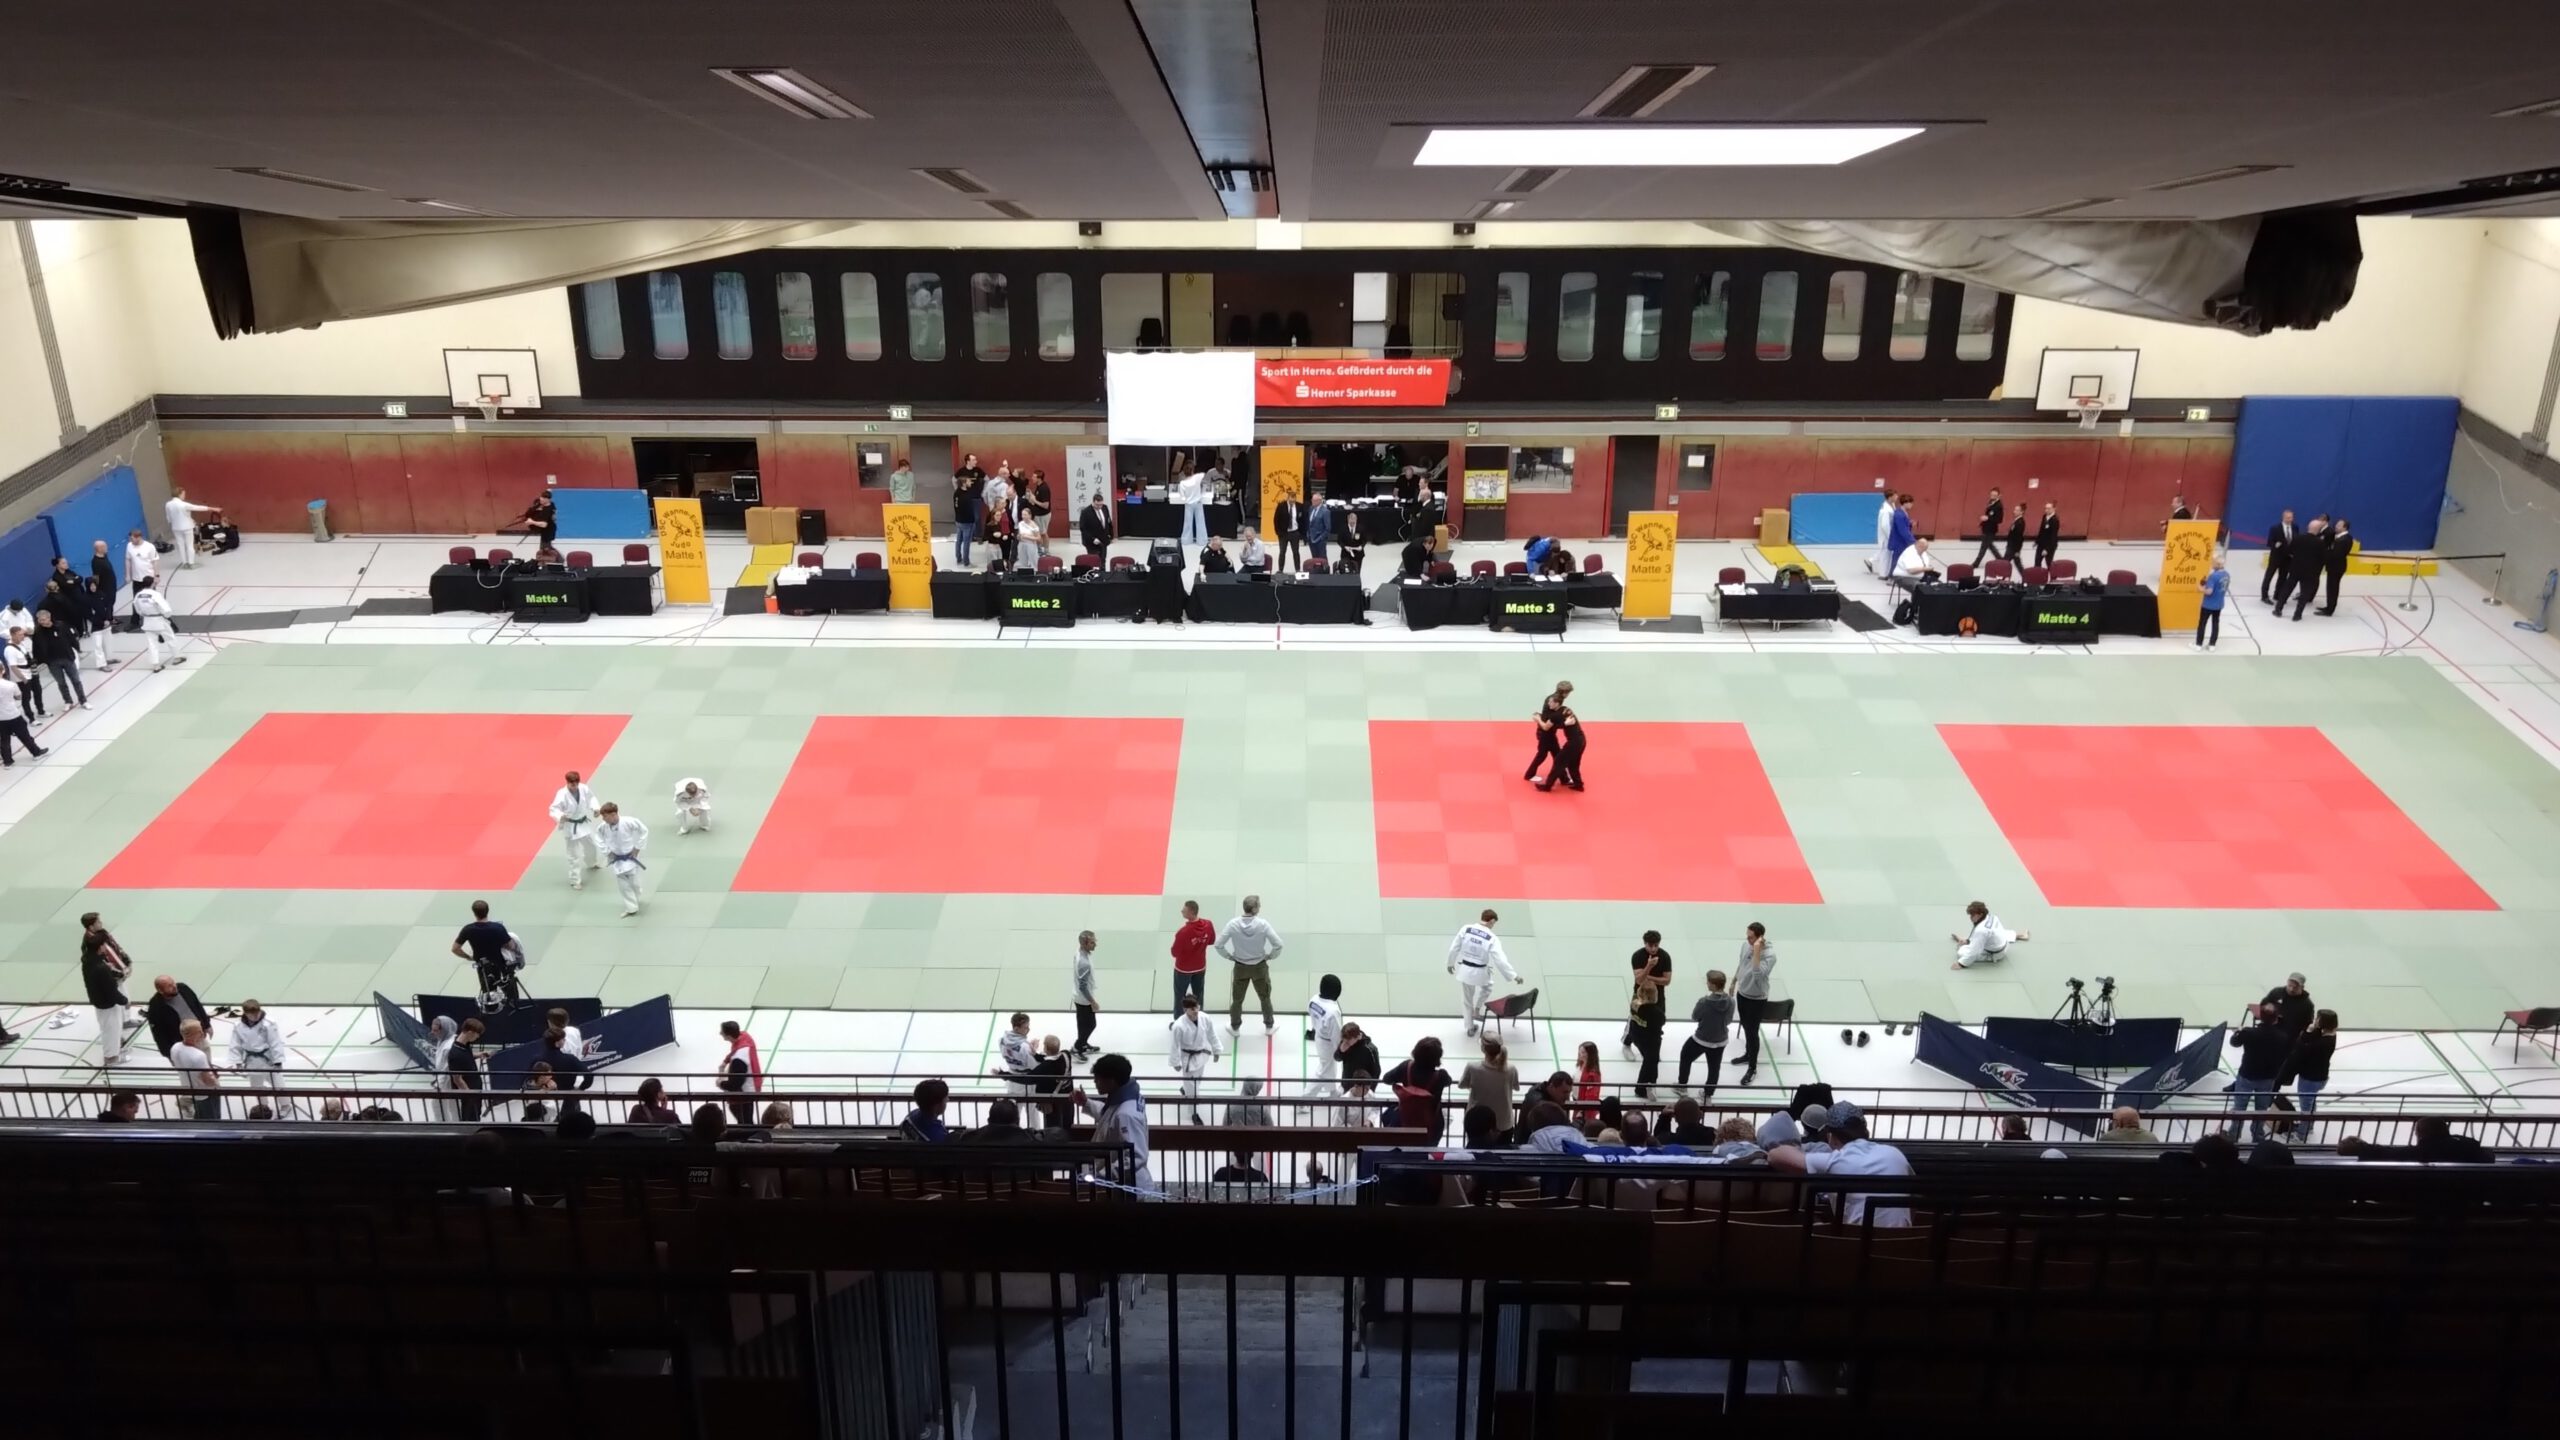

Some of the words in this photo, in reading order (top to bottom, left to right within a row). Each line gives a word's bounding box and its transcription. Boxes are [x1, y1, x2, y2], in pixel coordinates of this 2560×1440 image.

[1261, 367, 1288, 378] Sport
[1290, 366, 1300, 376] in
[1302, 367, 1335, 376] Herne.
[1337, 366, 1384, 376] Gefördert
[1386, 365, 1414, 375] durch
[1416, 365, 1432, 375] die
[1311, 389, 1344, 398] Herner
[1346, 388, 1397, 399] Sparkasse
[670, 541, 691, 549] Judo
[897, 546, 918, 554] Judo
[665, 550, 695, 560] Matte
[1638, 555, 1660, 563] Judo
[891, 556, 921, 566] Matte
[924, 556, 931, 566] 2
[1631, 564, 1662, 574] Matte
[1665, 564, 1672, 574] 3
[2174, 564, 2196, 573] Judo
[2372, 563, 2381, 575] 3
[2165, 575, 2197, 585] Matte
[525, 594, 558, 603] Matte
[561, 594, 568, 603] 1
[1012, 598, 1049, 609] Matte
[1052, 598, 1061, 609] 2
[1505, 602, 1543, 613] Matte
[1546, 602, 1555, 613] 3
[2038, 612, 2077, 624] Matte
[2080, 612, 2090, 624] 4
